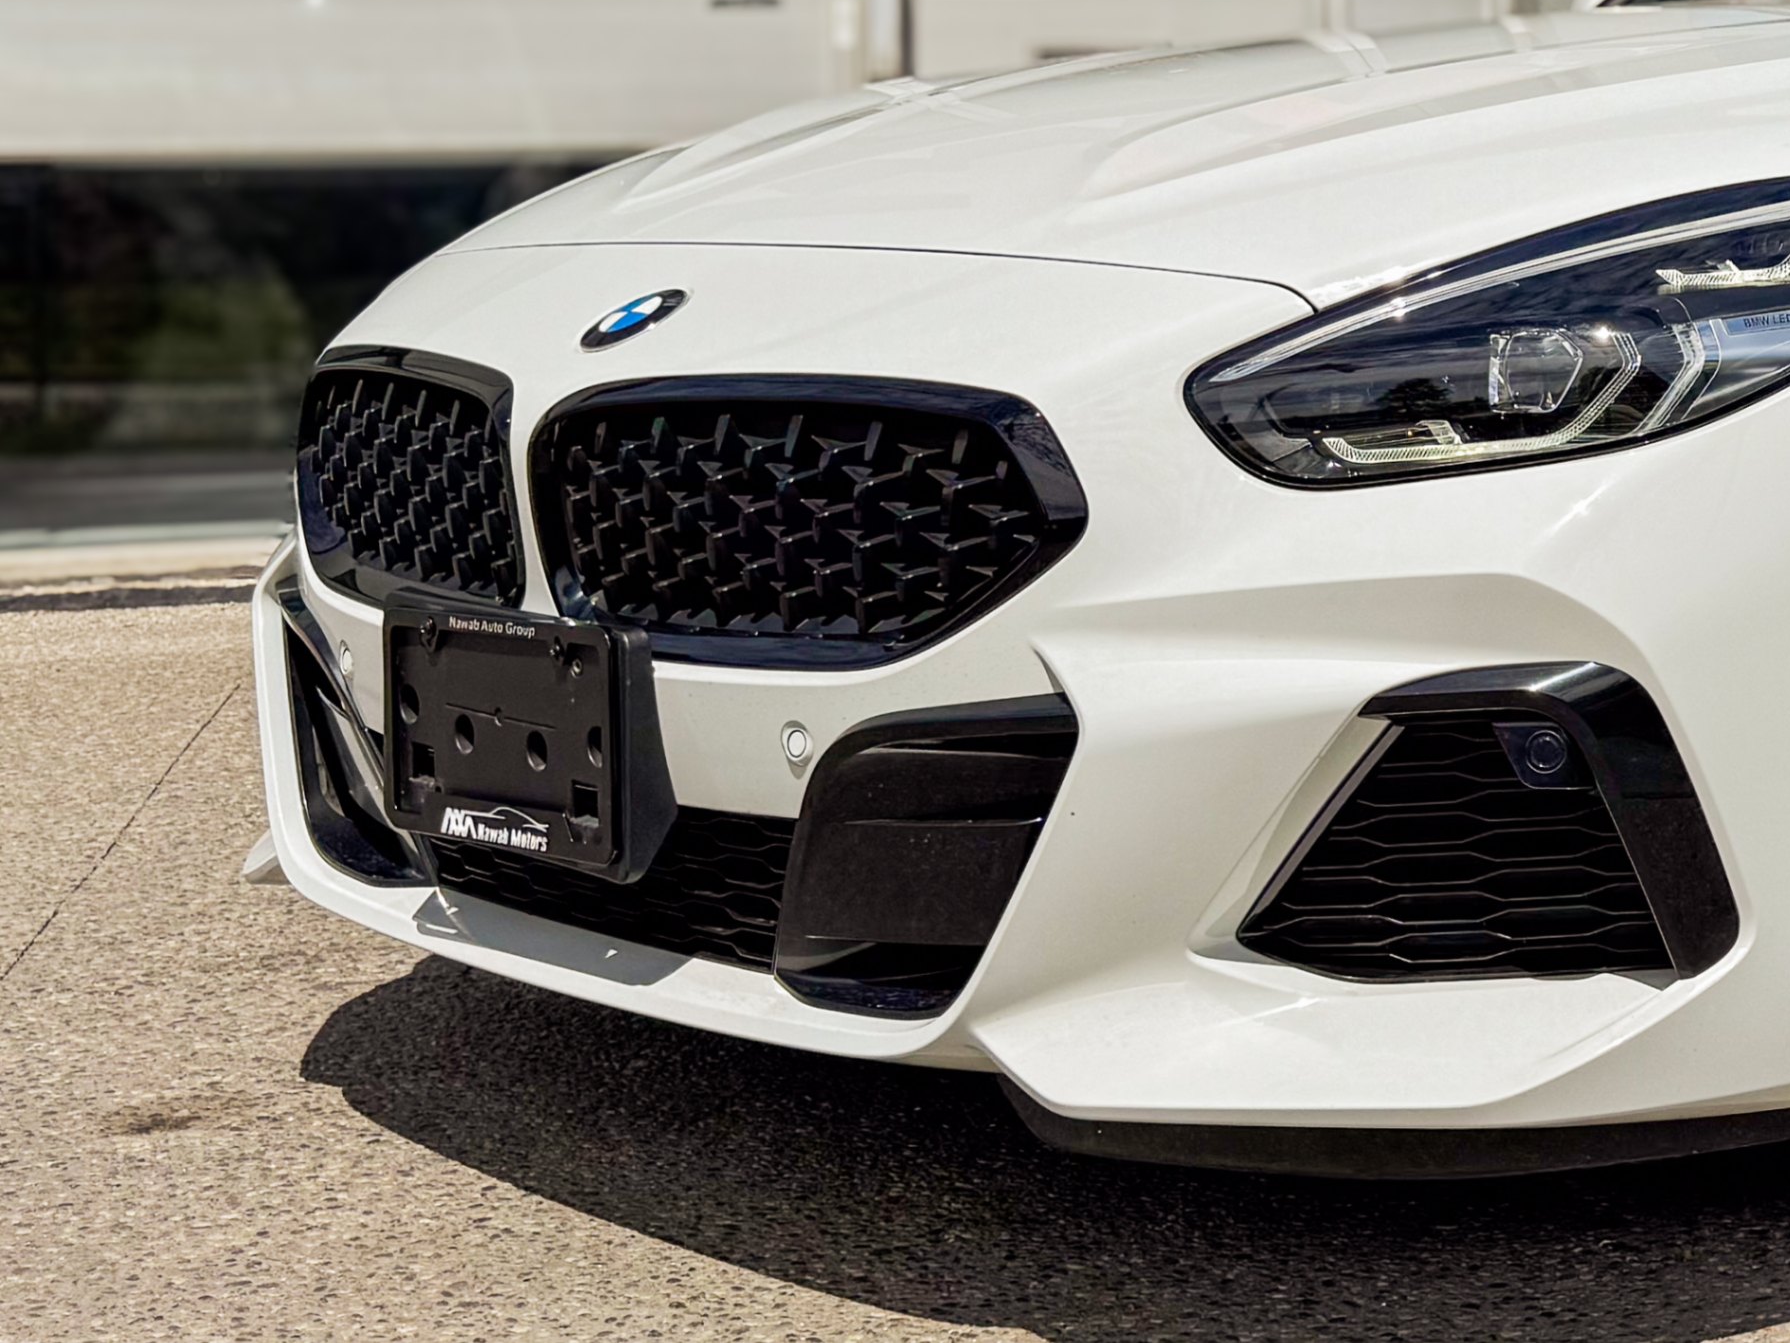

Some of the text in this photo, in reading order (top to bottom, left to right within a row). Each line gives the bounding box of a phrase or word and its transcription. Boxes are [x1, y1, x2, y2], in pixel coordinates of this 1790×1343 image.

[449, 615, 535, 639] Nawab Auto Group
[477, 823, 548, 852] Nawab Motors
